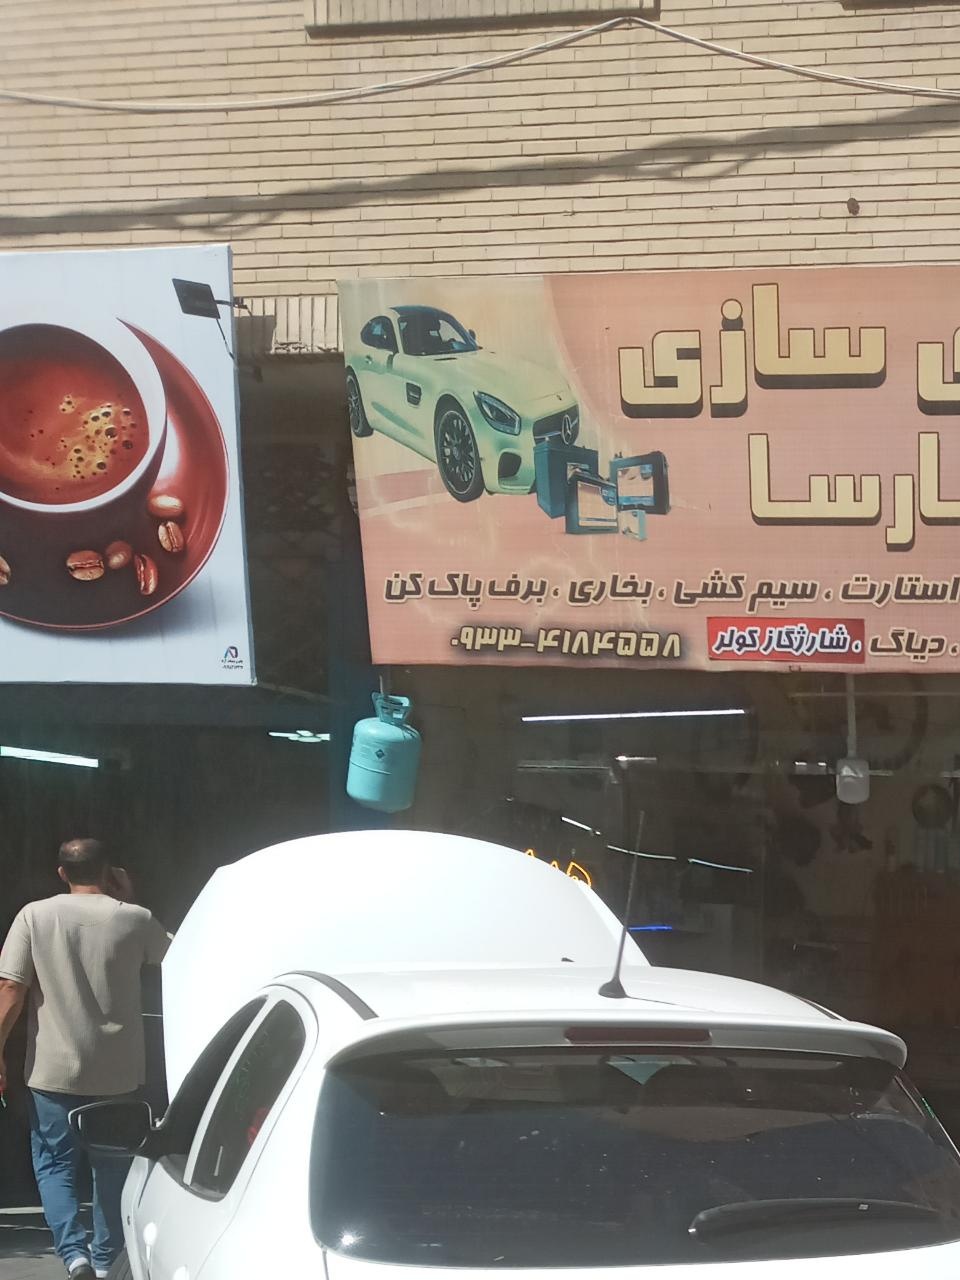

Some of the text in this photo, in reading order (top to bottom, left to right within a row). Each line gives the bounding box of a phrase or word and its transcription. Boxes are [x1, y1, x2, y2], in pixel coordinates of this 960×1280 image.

[618, 283, 886, 418] سازی
[384, 572, 424, 602] کن
[427, 572, 484, 610] پاک
[488, 572, 548, 604] برف
[567, 573, 653, 606] بخاری
[672, 569, 746, 607] کشی
[746, 579, 819, 614] سیم
[713, 627, 759, 655] کولر
[869, 629, 947, 661] دیاگ
